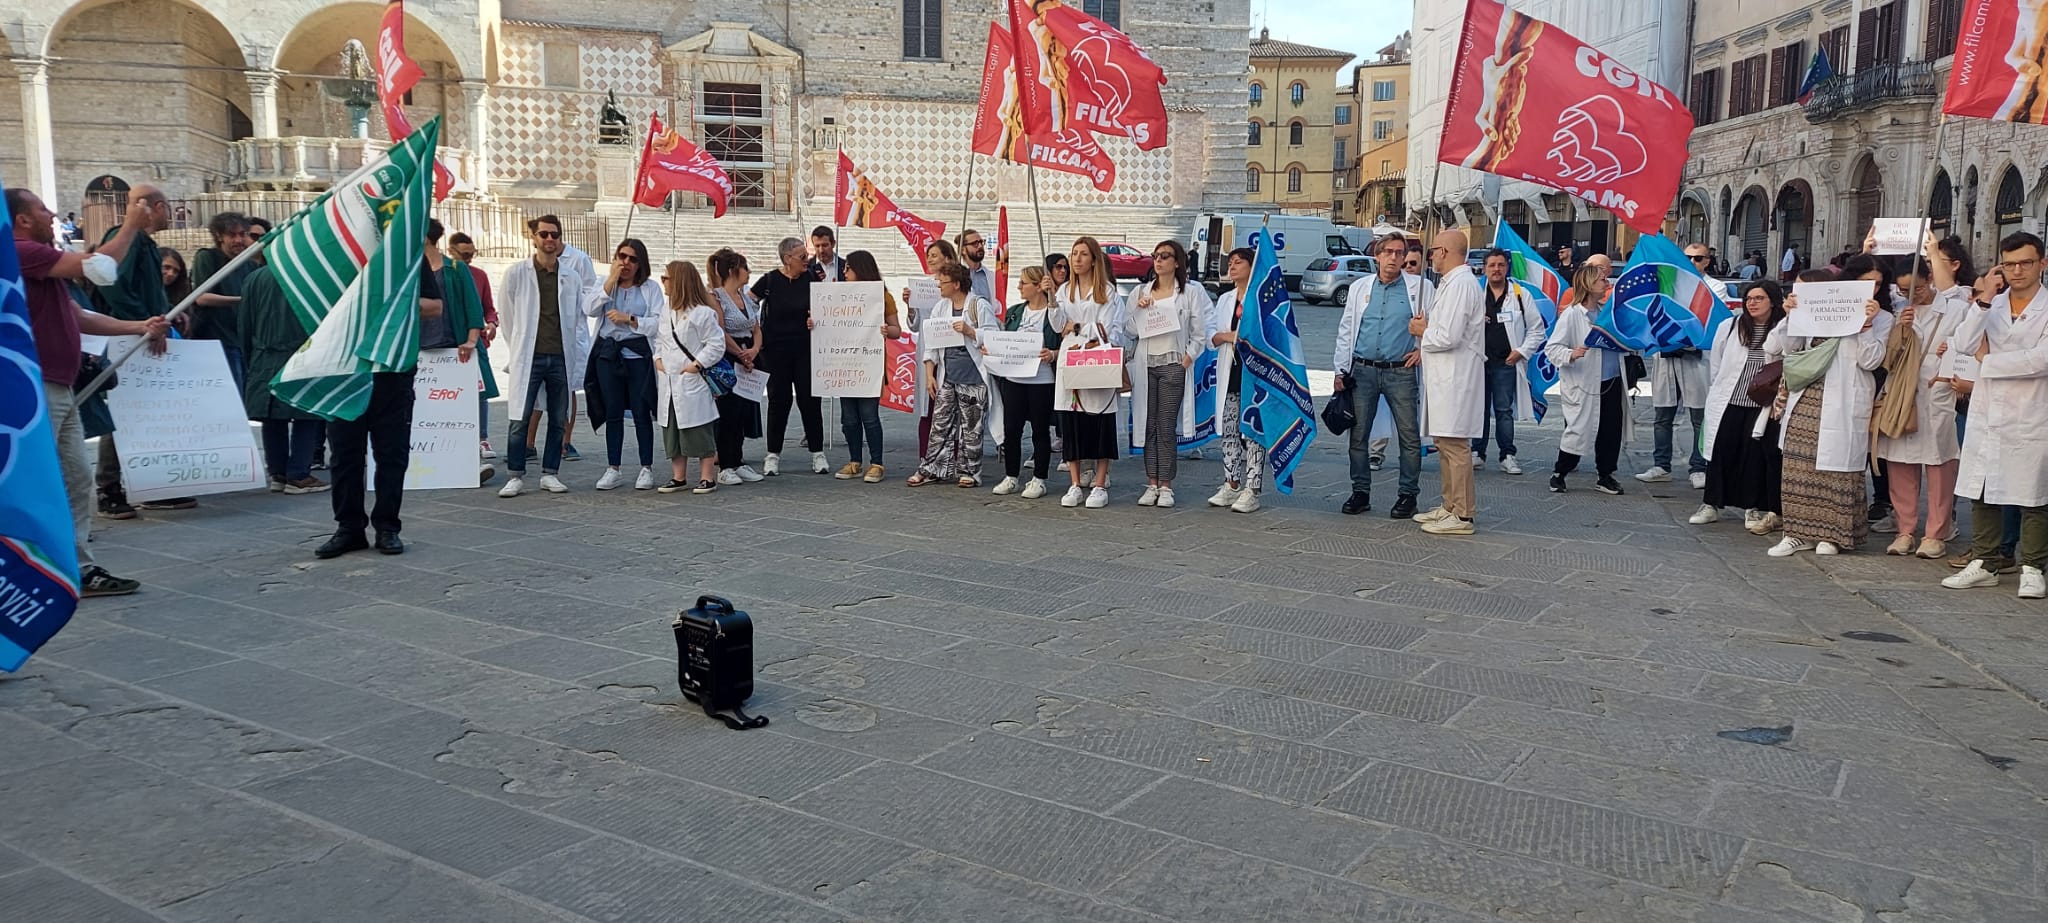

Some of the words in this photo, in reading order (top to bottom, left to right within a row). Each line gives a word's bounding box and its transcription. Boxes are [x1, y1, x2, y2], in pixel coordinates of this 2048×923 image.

[1030, 143, 1109, 184] FILCAMS
[1248, 232, 1286, 251] GS
[816, 369, 865, 378] CONTRATTO
[1246, 355, 1268, 376] Unione
[1267, 367, 1292, 392] Italiana
[418, 420, 476, 430] CONTRATTO
[127, 453, 219, 470] CONTRATTO
